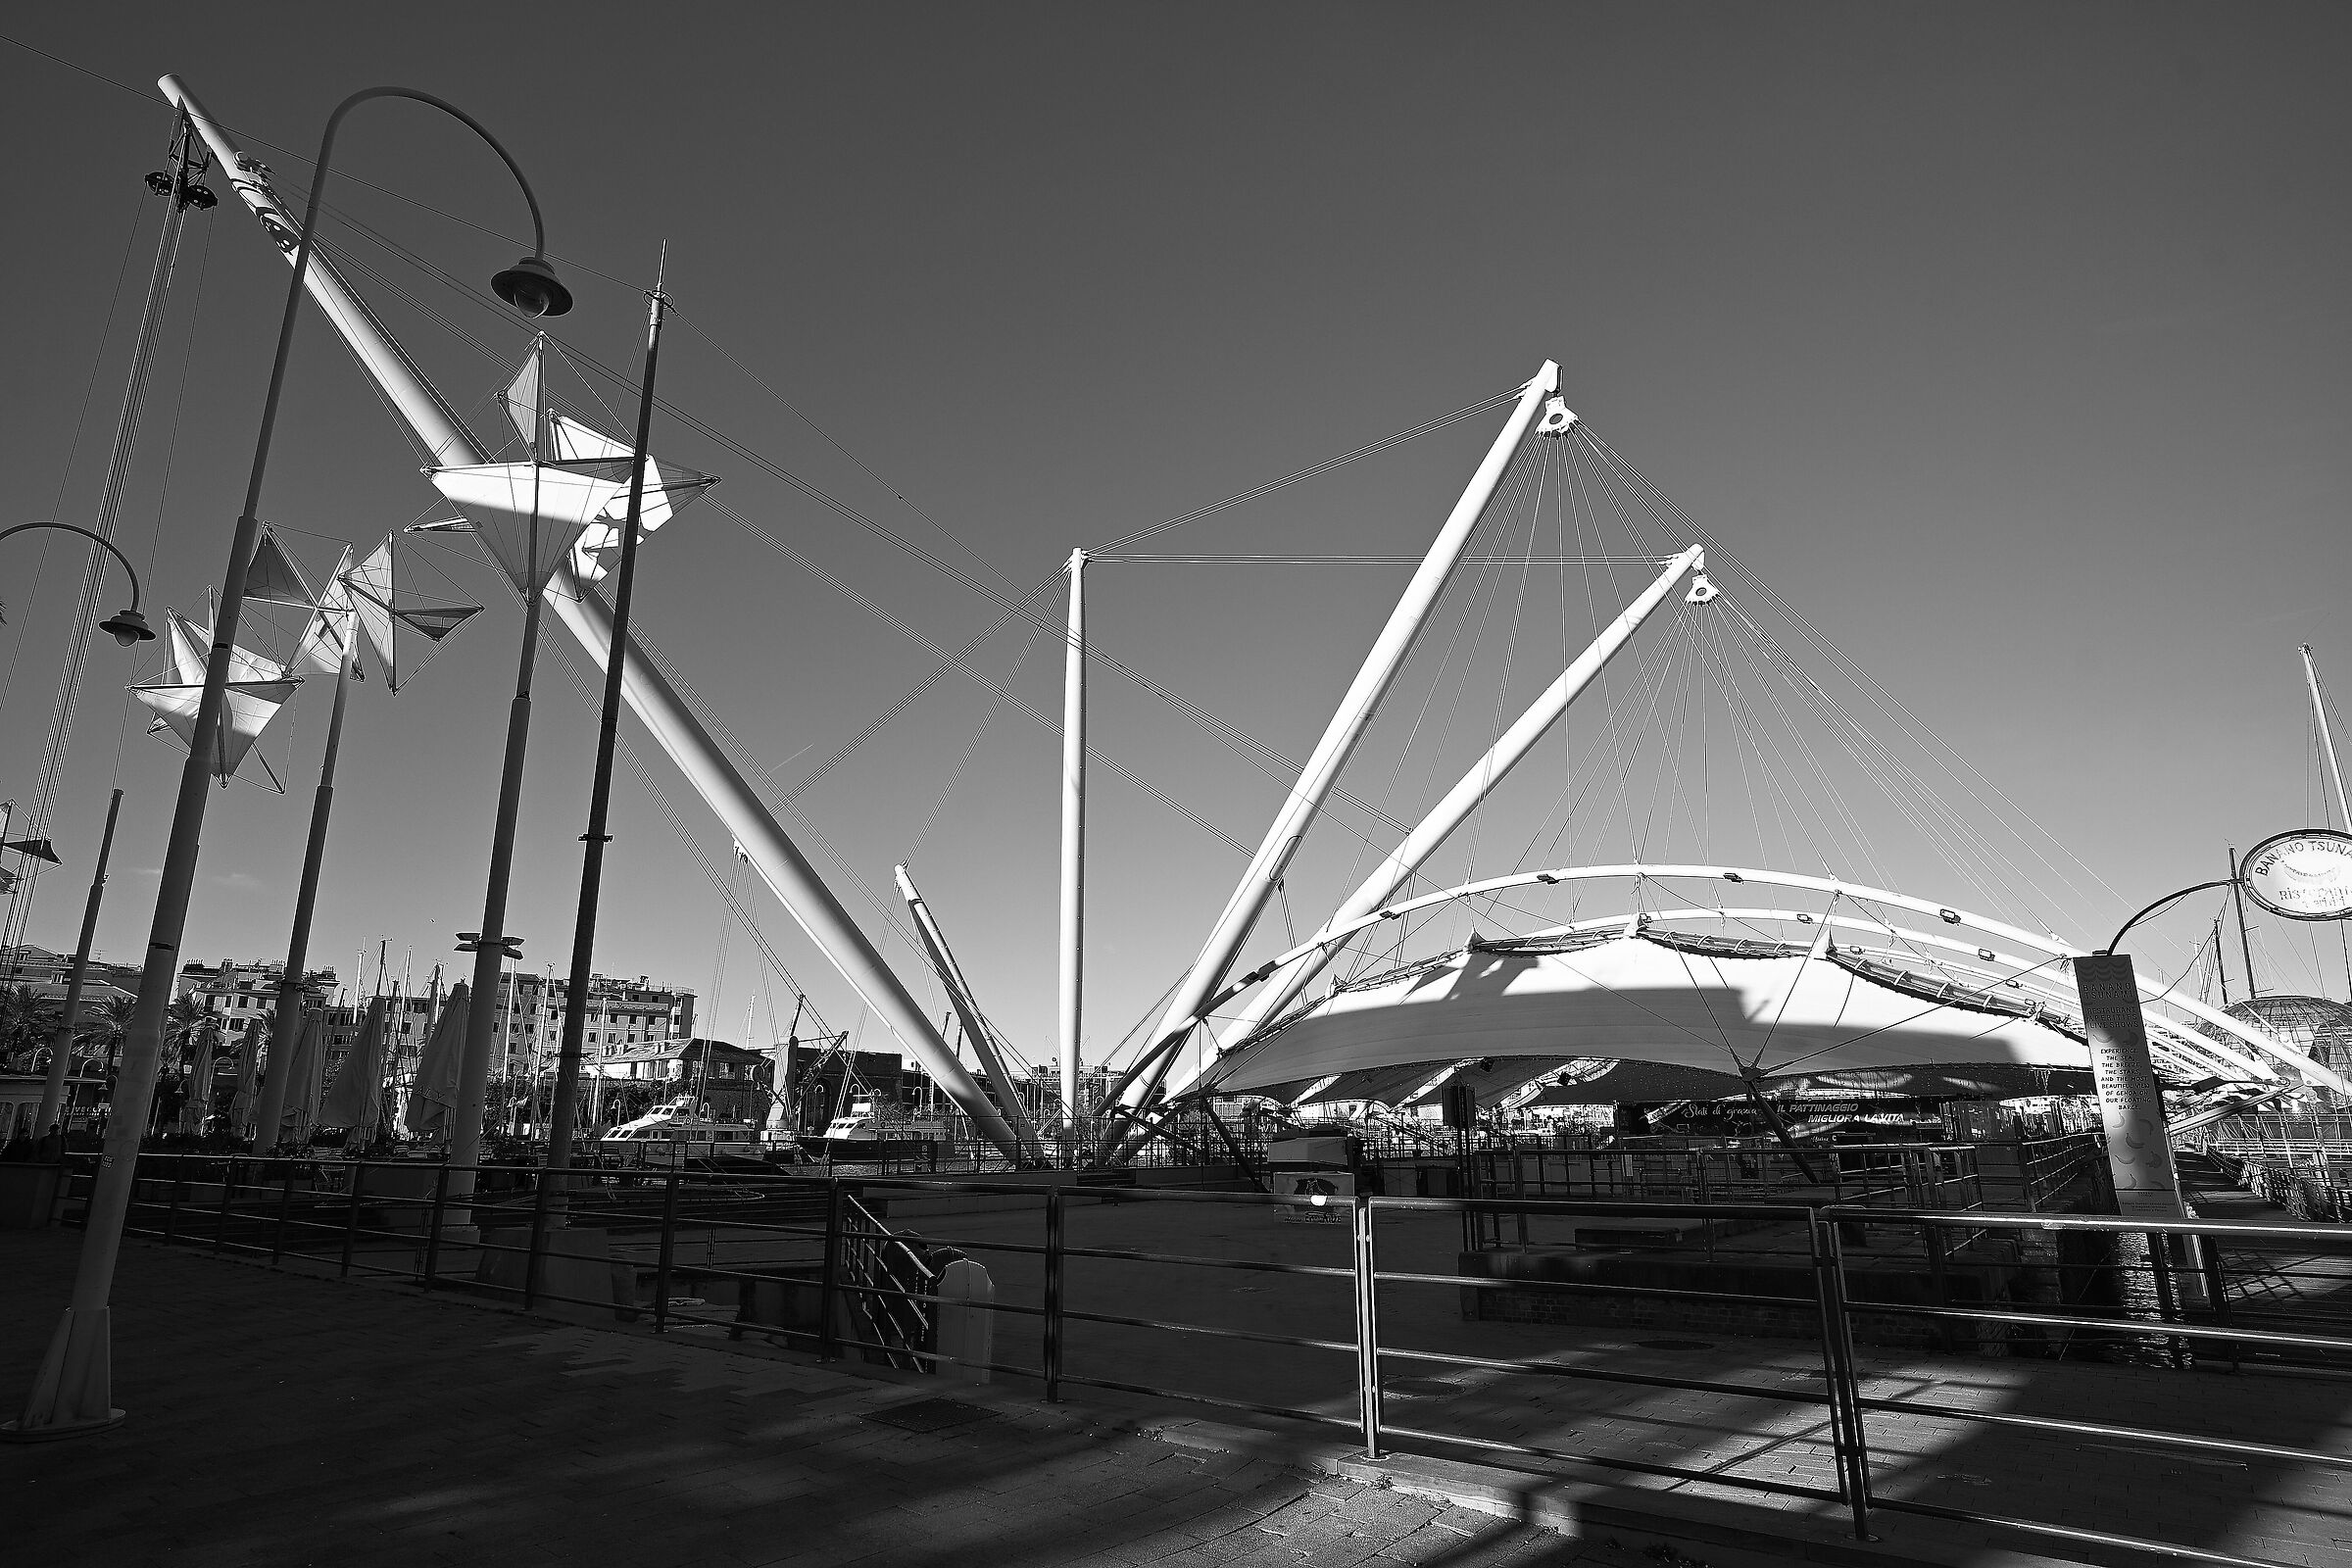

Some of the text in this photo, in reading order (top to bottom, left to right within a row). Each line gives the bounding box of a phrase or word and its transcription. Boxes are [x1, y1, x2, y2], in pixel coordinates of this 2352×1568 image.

[2082, 982, 2132, 992] BANANO
[2085, 990, 2133, 999] TSUNAMI
[1681, 1103, 1708, 1118] Stati
[1723, 1106, 1758, 1121] grazia
[1789, 1103, 1859, 1112] PATTINAGGIO
[1808, 1113, 1860, 1123] MIGLIORA
[1880, 1112, 1904, 1122] VITA
